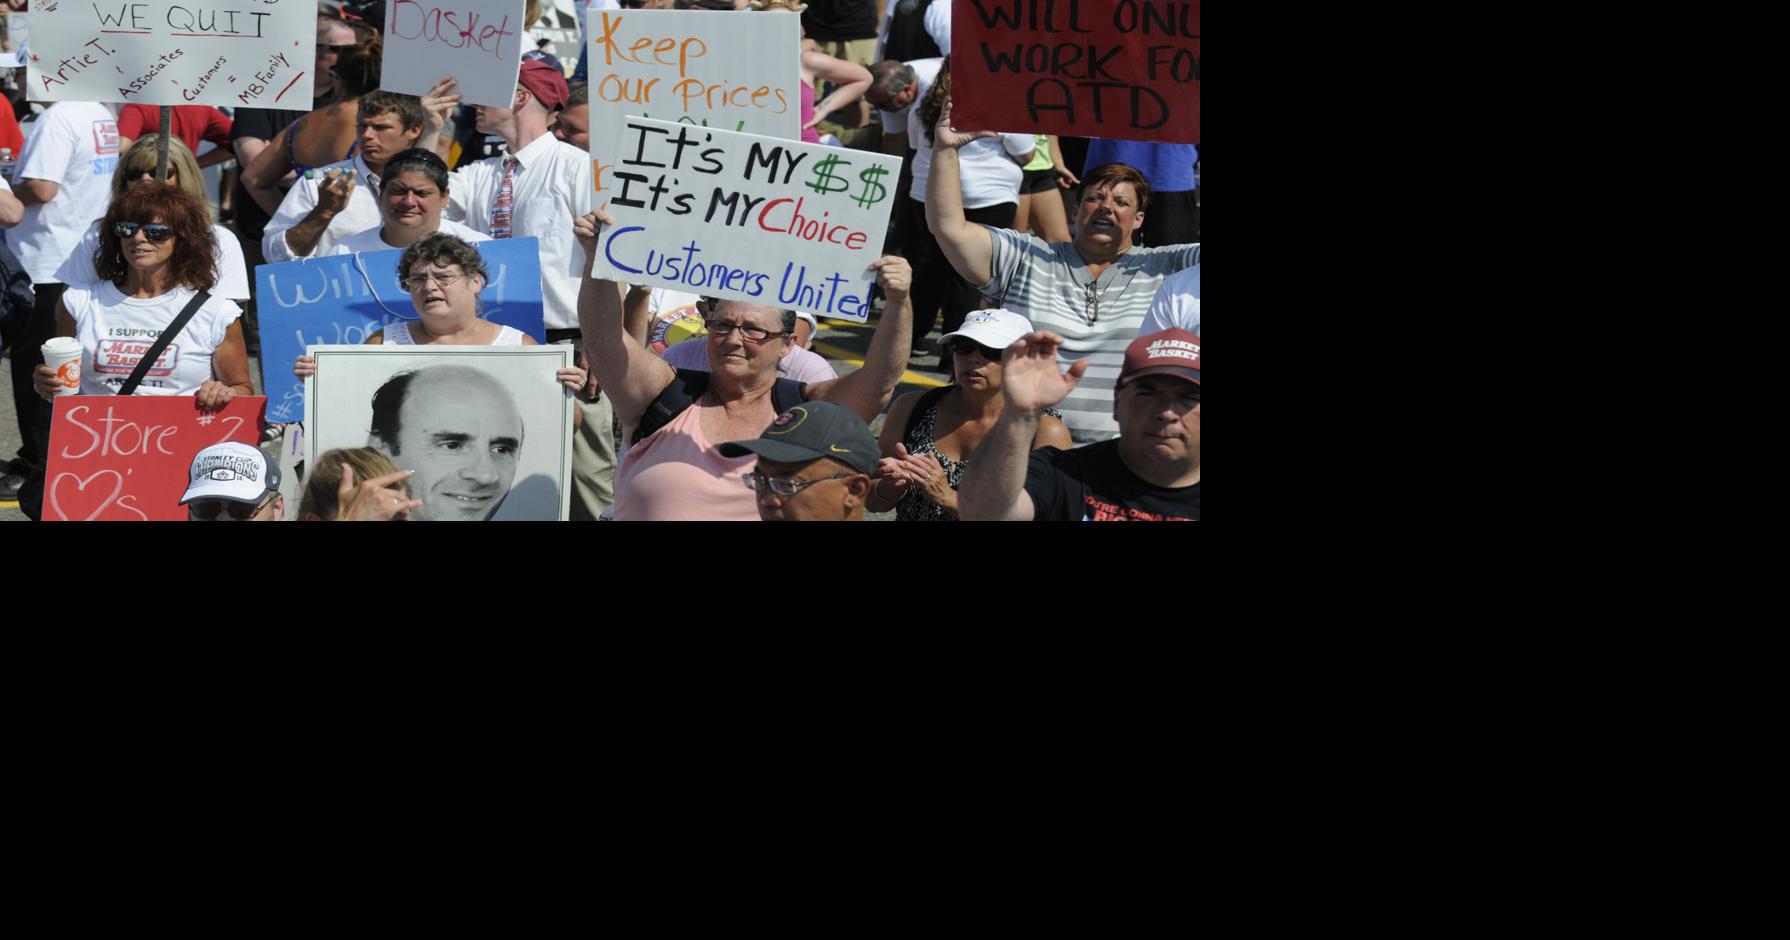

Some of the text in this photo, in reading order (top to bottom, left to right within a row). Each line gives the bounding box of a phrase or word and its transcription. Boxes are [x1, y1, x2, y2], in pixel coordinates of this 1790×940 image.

[93, 3, 271, 38] WE QUIT
[972, 0, 1094, 34] WILL
[41, 37, 116, 92] Artie T.
[596, 13, 707, 77] Keep
[979, 42, 1199, 83] WORK FO
[118, 48, 184, 99] Associates
[183, 56, 226, 101] Customers
[1026, 78, 1170, 130] ATD
[622, 123, 724, 174] It's
[743, 142, 808, 184] MY
[610, 171, 696, 215] It's
[757, 196, 867, 250] Choice
[268, 262, 370, 308] Will
[604, 226, 875, 319] Customers United
[1147, 348, 1199, 360] BASKET
[61, 405, 178, 459] Store
[194, 459, 260, 482] CHAMPIONS
